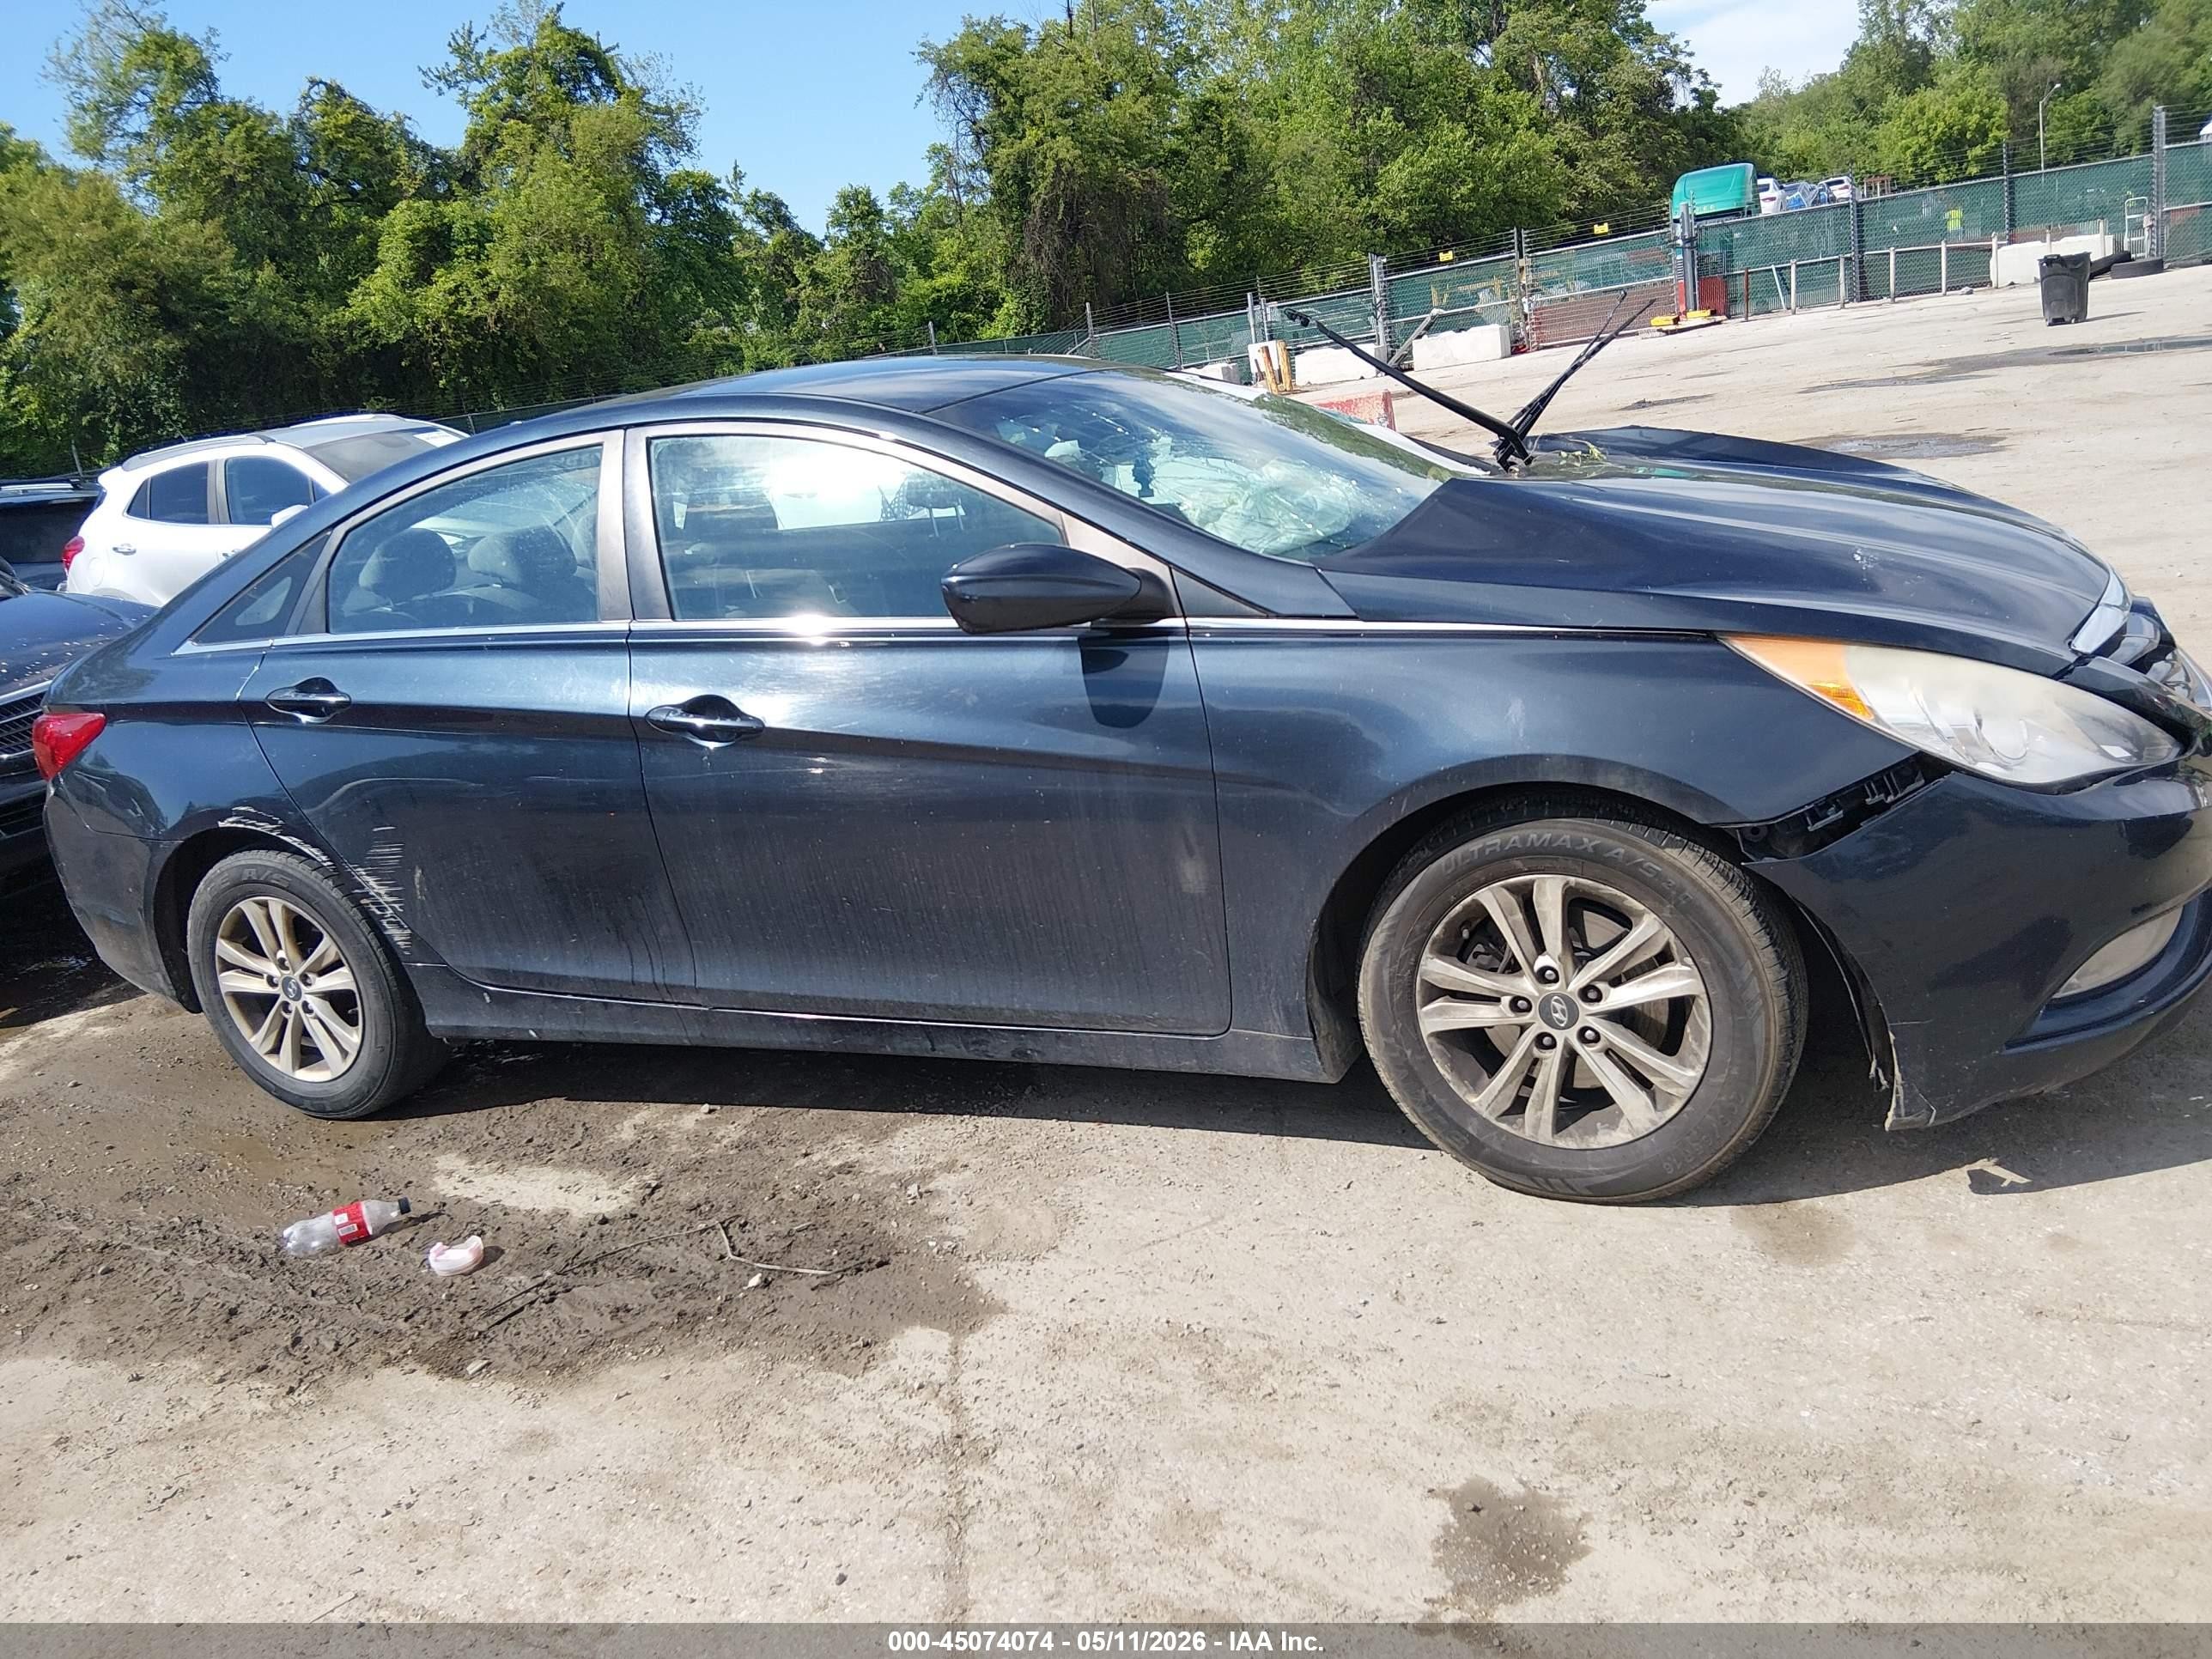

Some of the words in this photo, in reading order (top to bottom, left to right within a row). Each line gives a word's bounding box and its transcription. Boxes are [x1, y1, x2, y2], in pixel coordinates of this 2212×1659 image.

[1442, 830, 1601, 874] ULTRAMAX
[1603, 848, 1662, 878] A/S
[241, 868, 292, 888] A/S
